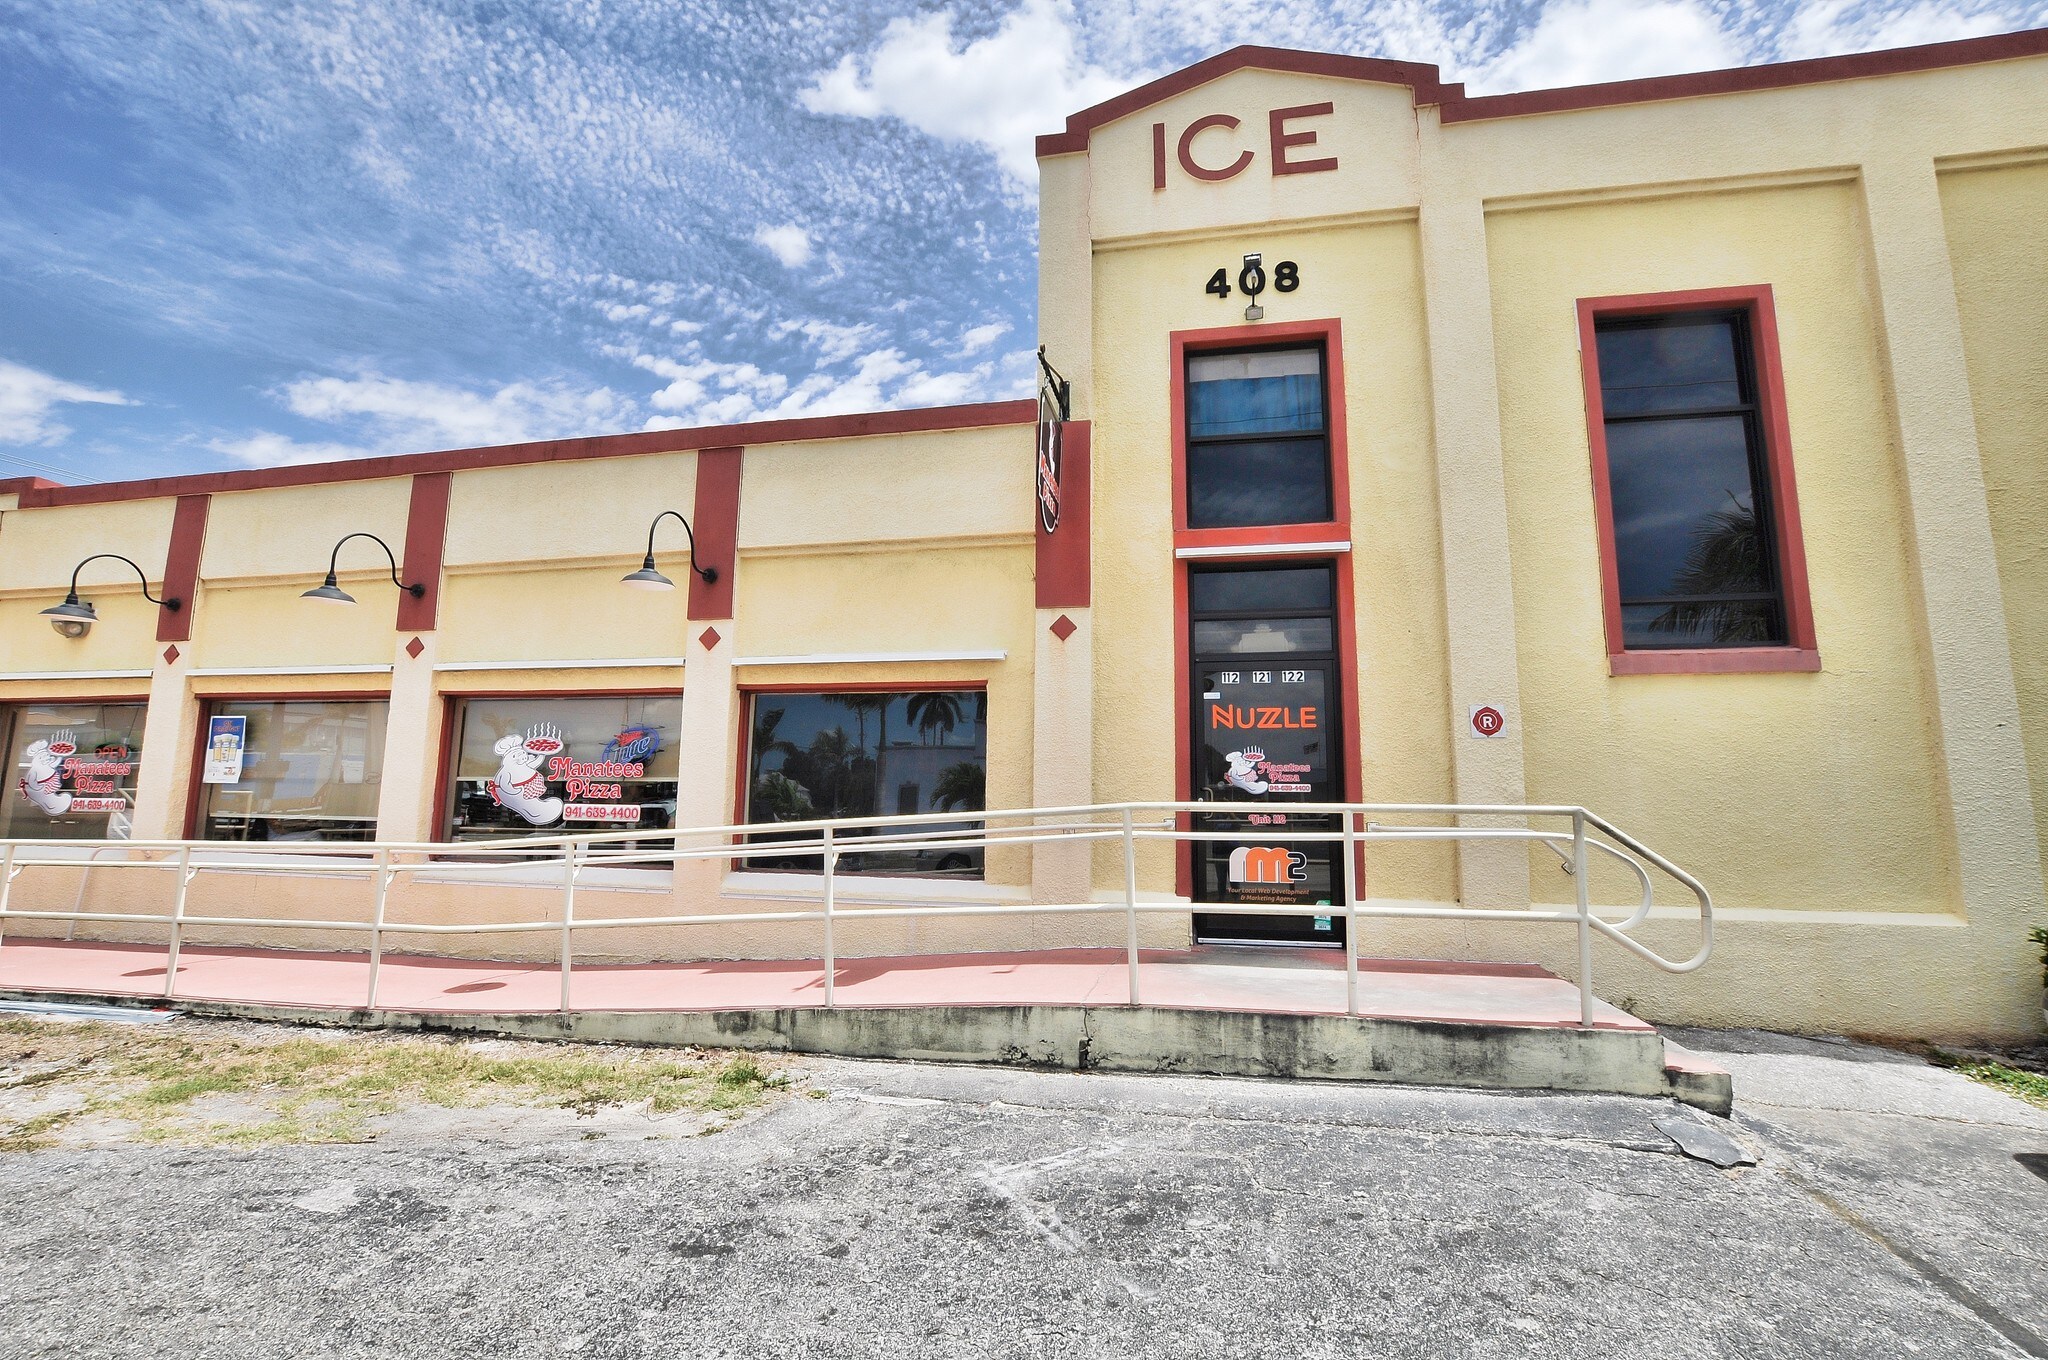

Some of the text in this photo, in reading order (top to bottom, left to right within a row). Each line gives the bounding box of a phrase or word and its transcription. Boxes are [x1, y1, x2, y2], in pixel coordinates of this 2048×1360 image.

[1152, 101, 1339, 190] ICE
[1205, 261, 1300, 298] 408
[1222, 671, 1304, 683] 112 121 122
[1212, 704, 1316, 729] NUZZLE
[1482, 716, 1493, 728] R
[94, 746, 128, 760] OPEN
[62, 757, 131, 779] Manatees
[548, 757, 643, 780] Manatees
[1269, 772, 1300, 783] Pizza
[75, 775, 115, 796] Pizza
[567, 779, 621, 801] Pizza
[72, 799, 125, 811] 941-639-4400
[565, 805, 639, 819] 941-639-4400
[1248, 814, 1271, 825] Unit
[1272, 888, 1310, 896] Development
[1246, 895, 1275, 903] Marketing
[1276, 896, 1297, 904] Agency
